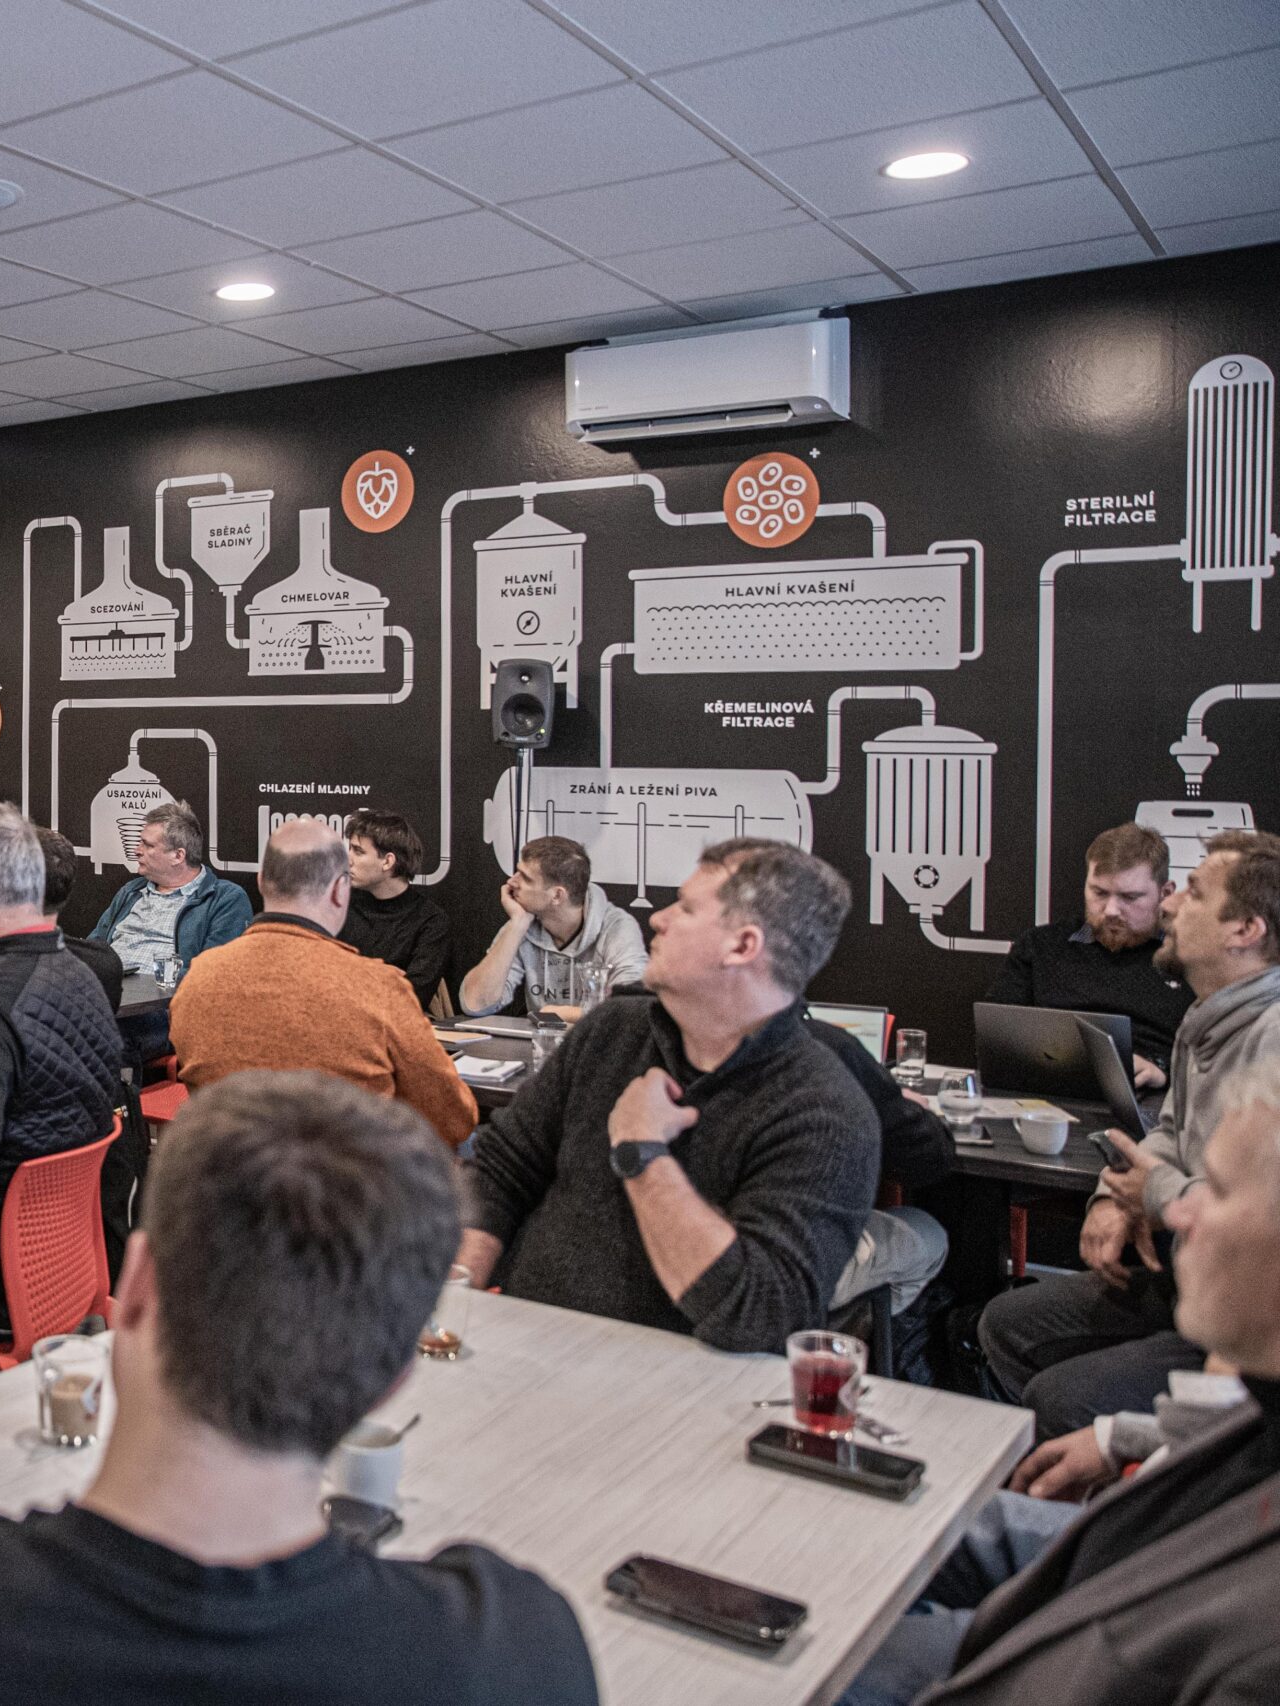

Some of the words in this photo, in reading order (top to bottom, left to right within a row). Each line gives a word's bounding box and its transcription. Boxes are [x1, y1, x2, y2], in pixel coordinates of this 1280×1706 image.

[1066, 489, 1155, 511] STERILNÍ
[1064, 509, 1157, 527] FILTRACE
[209, 523, 252, 537] SBĚRAČ
[207, 537, 253, 549] SLADINY
[504, 570, 553, 585] HLAVNÍ
[500, 582, 557, 598] KVAŠENÍ
[725, 582, 781, 597] HLAVNÍ
[786, 579, 855, 595] KVAŠENÍ
[280, 591, 350, 604] CHMELOVAR
[90, 601, 144, 614] SCEZOVÁNÍ
[704, 700, 815, 714] KŘEMELINOVÁ
[722, 716, 795, 728] FILTRACE
[106, 789, 162, 799] USAZOVÁNÍ
[258, 782, 315, 794] CHLAZENÍ
[318, 784, 371, 795] MLADINY
[569, 783, 611, 795] ZRÁNÍ
[615, 785, 625, 795] A
[630, 783, 680, 796] LEŽENÍ
[684, 786, 718, 797] PIVA
[121, 799, 147, 810] KALŮ
